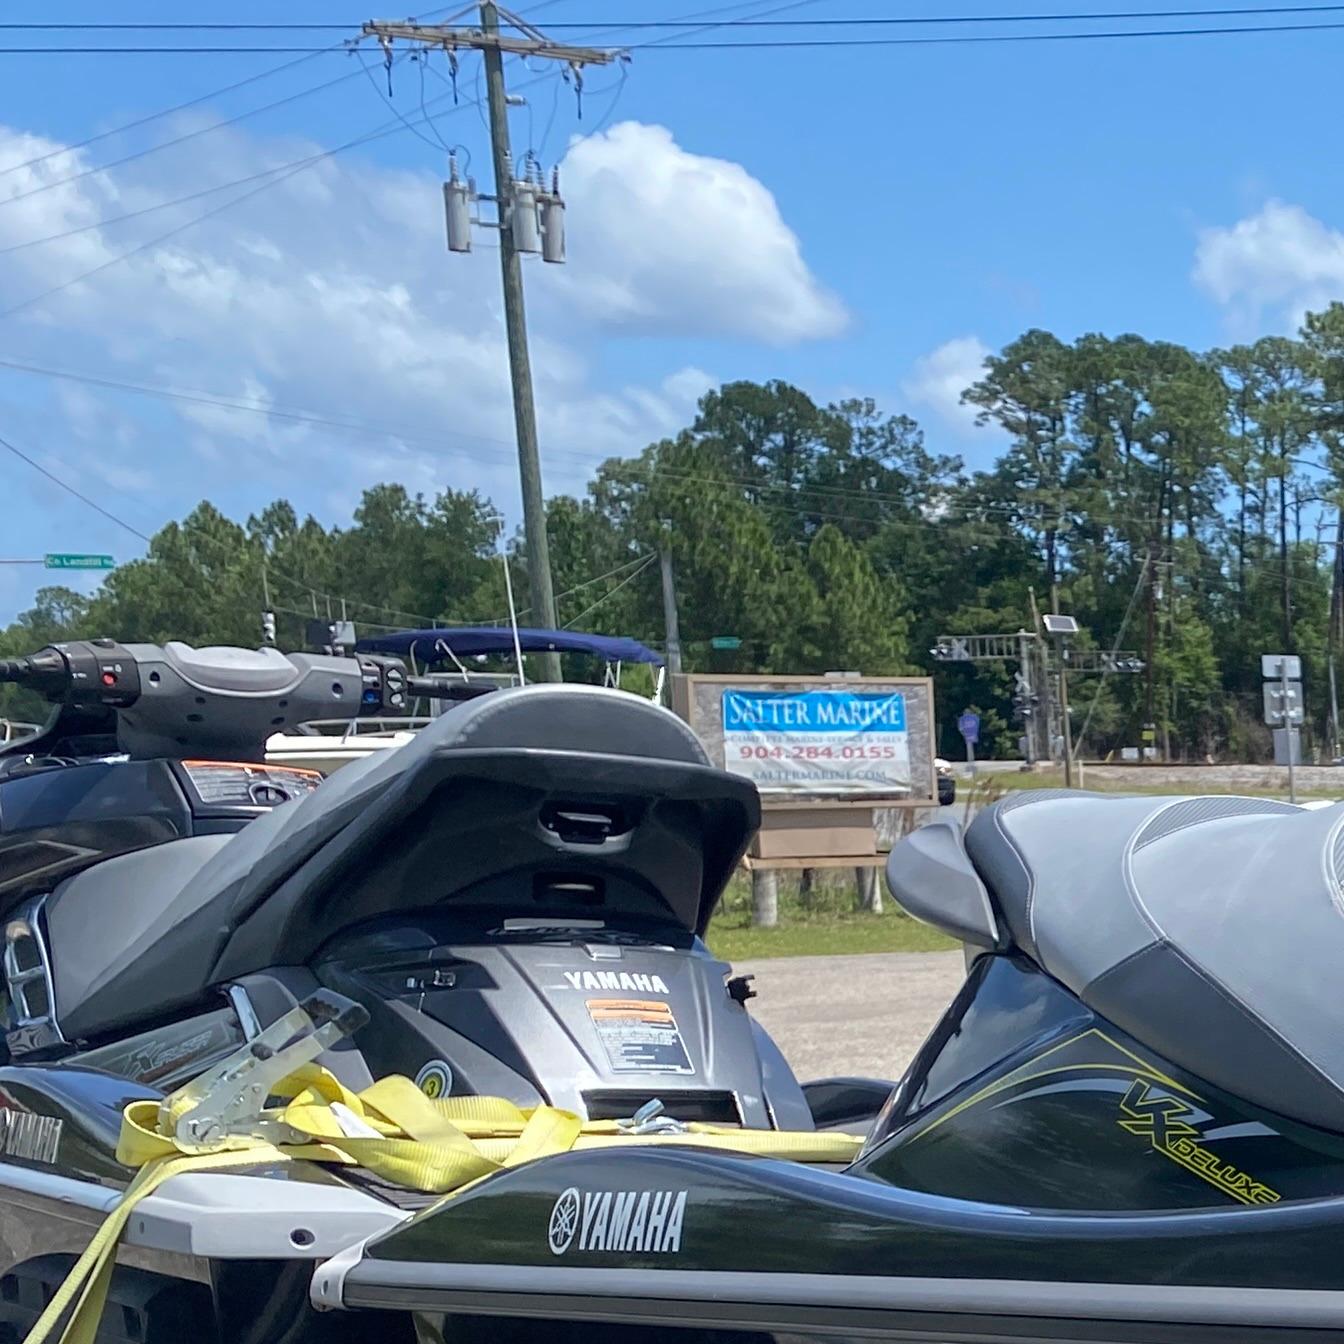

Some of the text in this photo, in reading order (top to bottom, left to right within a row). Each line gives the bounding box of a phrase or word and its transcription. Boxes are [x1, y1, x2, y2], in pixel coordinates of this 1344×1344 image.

[730, 695, 900, 725] SALTER MARINE
[740, 745, 896, 759] 904.284.0155
[563, 971, 670, 994] YAMAHA
[426, 1080, 437, 1096] 3
[1172, 1137, 1281, 1205] DELUXE
[578, 1189, 689, 1252] YAMAHA
